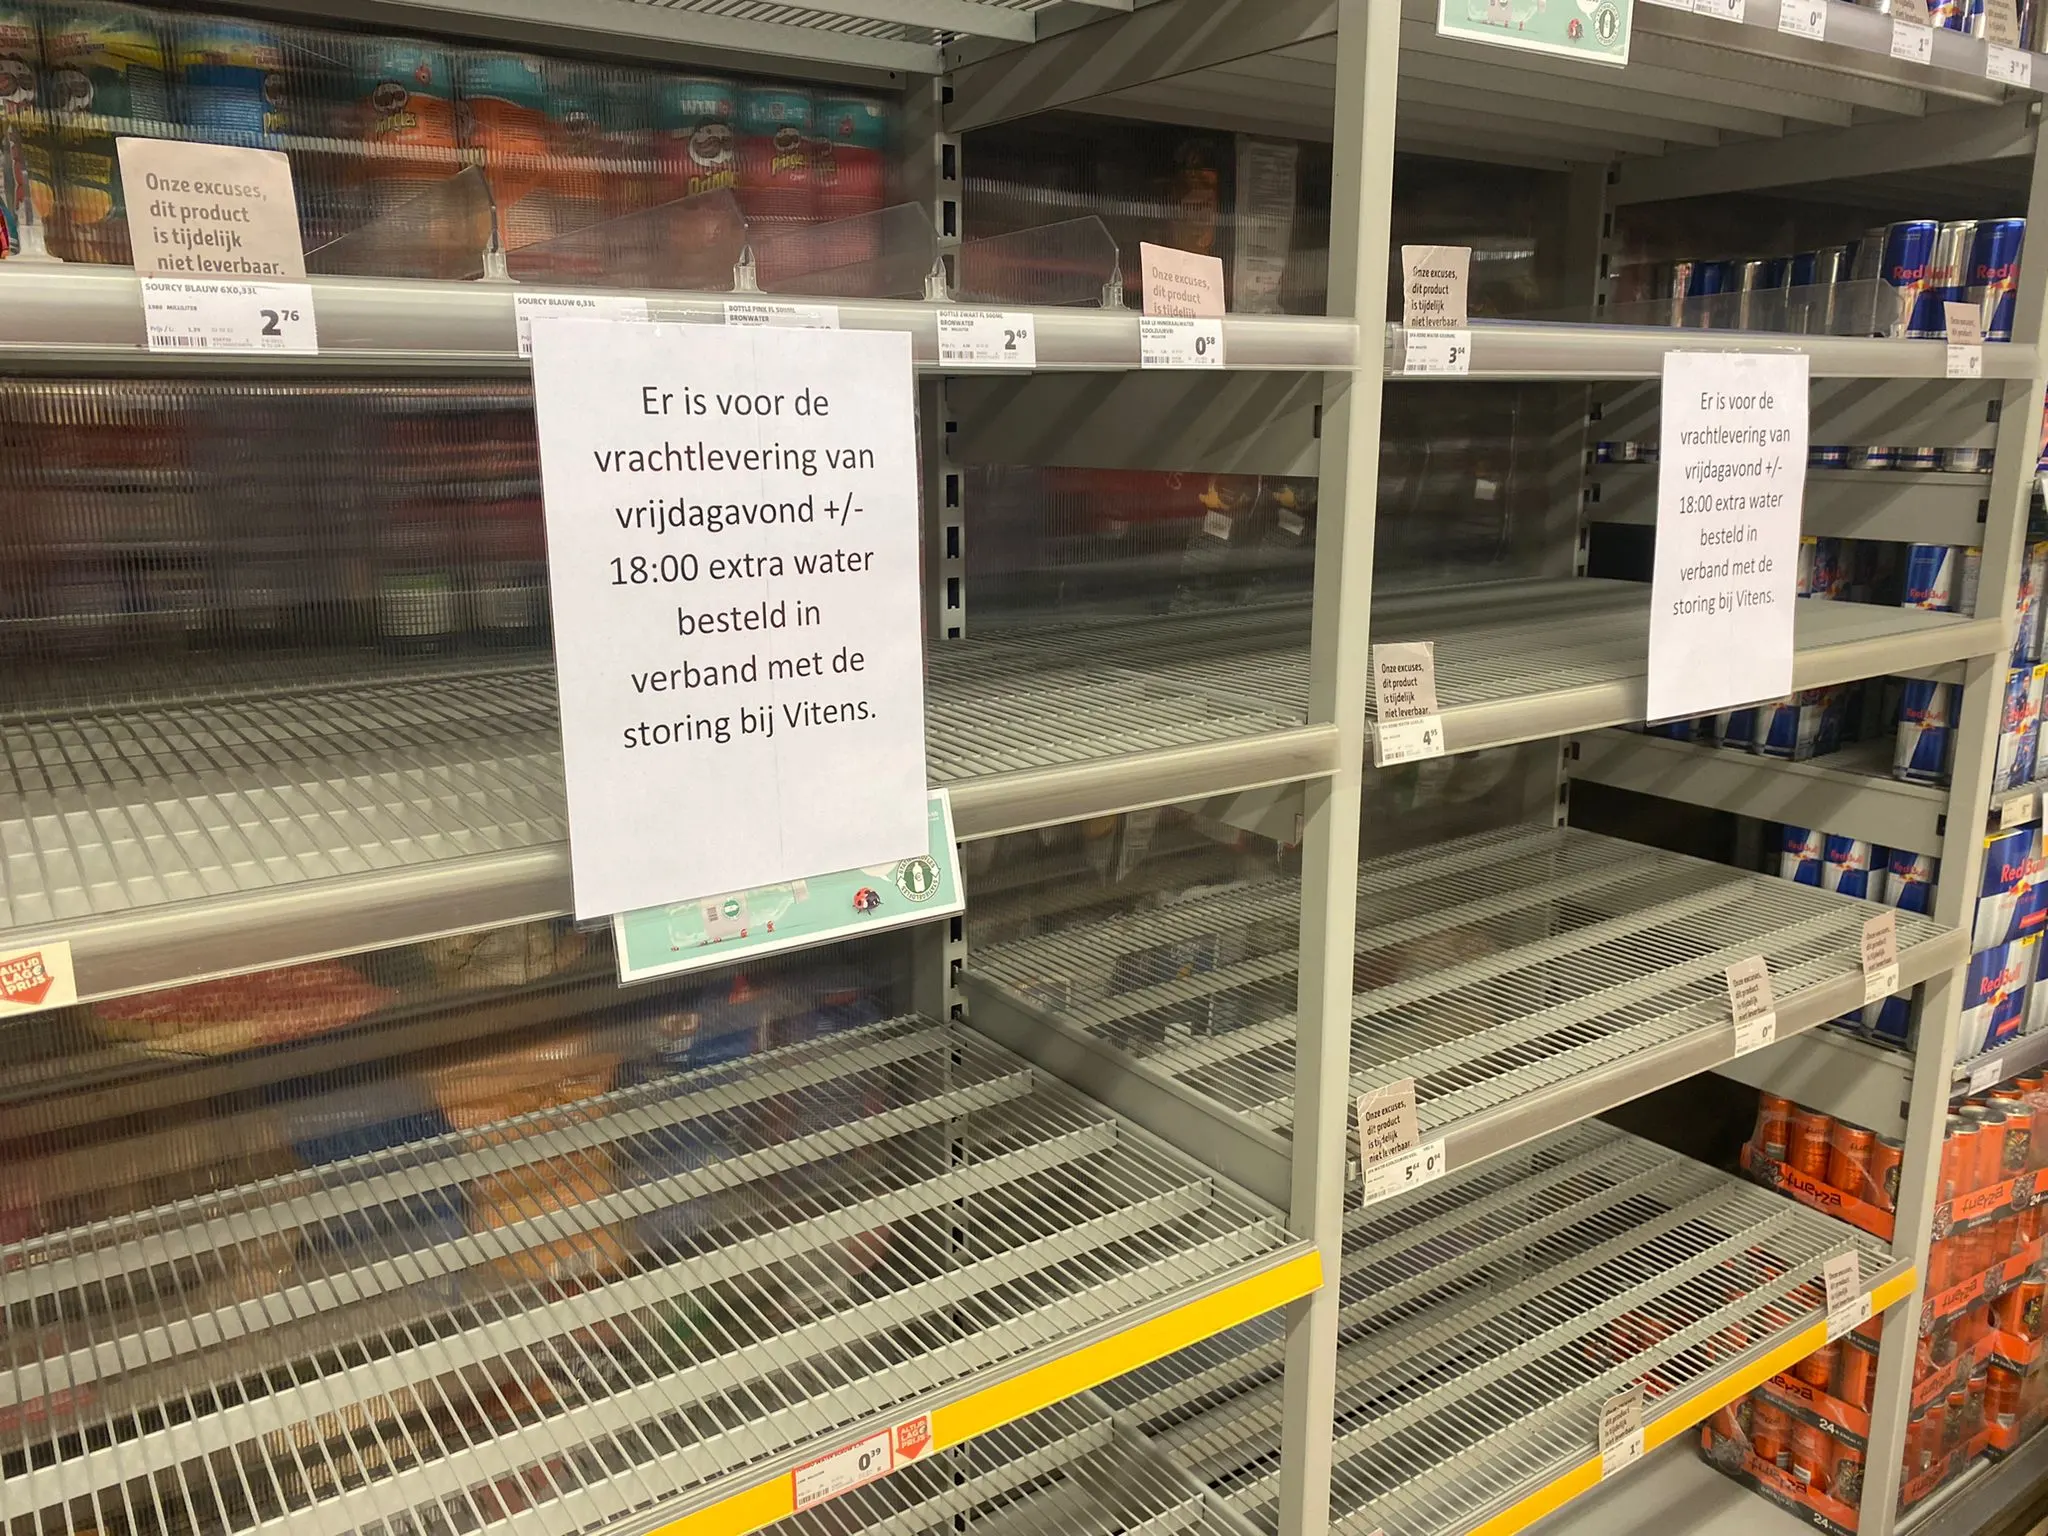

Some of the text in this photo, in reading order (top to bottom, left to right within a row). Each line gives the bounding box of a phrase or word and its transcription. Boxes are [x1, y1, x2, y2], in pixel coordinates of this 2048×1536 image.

[145, 172, 268, 202] Onze excuses,
[150, 200, 251, 225] dit product
[154, 226, 243, 253] is tijdelijk
[158, 254, 286, 276] niet leverbaar.
[1413, 266, 1458, 280] Onze excuses,
[1893, 264, 1925, 280] Red
[1976, 263, 2008, 279] Red
[145, 283, 183, 293] SOURCY
[185, 285, 219, 294] BLAUW
[1152, 266, 1211, 291] Onze excuses,
[1153, 284, 1201, 305] dit product
[1412, 283, 1449, 297] dit product
[517, 297, 547, 306] SOURCY
[549, 299, 576, 307] BLAUW
[1154, 302, 1161, 314] is
[1411, 300, 1445, 314] is tijdelijk
[729, 315, 770, 323] BRONWATER
[940, 319, 975, 327] BRONWATER
[1412, 317, 1425, 327] niet
[642, 386, 830, 417] Er is voor de
[1701, 390, 1774, 411] Er is voor de
[1680, 425, 1791, 448] vrachtlevering van
[594, 441, 875, 477] vrachtlevering van
[1685, 455, 1783, 484] vrijdagavond +/-
[1680, 491, 1784, 515] 18:00 extra water
[616, 492, 864, 536] vrijdagavond +/-
[1700, 524, 1758, 547] besteld in
[610, 549, 875, 586] 18:00 extra water
[1680, 554, 1773, 582] verband met de
[1673, 589, 1775, 616] storing bij Vitens.
[677, 600, 821, 636] besteld in
[631, 646, 865, 694] verband met de
[1381, 663, 1425, 674] Onze excuses,
[1383, 678, 1418, 691] dit product
[1384, 692, 1416, 706] is tijdelijk
[1385, 706, 1431, 719] niet leverbaar.
[623, 700, 877, 750] storing bij Vitens.
[2001, 856, 2025, 883] Red
[0, 957, 40, 977] ALTIJD
[6, 975, 46, 996] PRIJS
[1980, 961, 2025, 995] Red Bull
[1365, 1101, 1407, 1122] Onze excuses,
[1377, 1115, 1401, 1135] product
[1368, 1140, 1374, 1150] is
[1369, 1151, 1383, 1164] niet
[1382, 1140, 1413, 1159] leverbaar.
[1786, 1172, 1842, 1208] fuerza
[1962, 1186, 2005, 1213] fuerza
[1819, 1418, 1835, 1434] 24
[901, 1435, 926, 1449] PRIJS
[1813, 1513, 1829, 1529] 24
